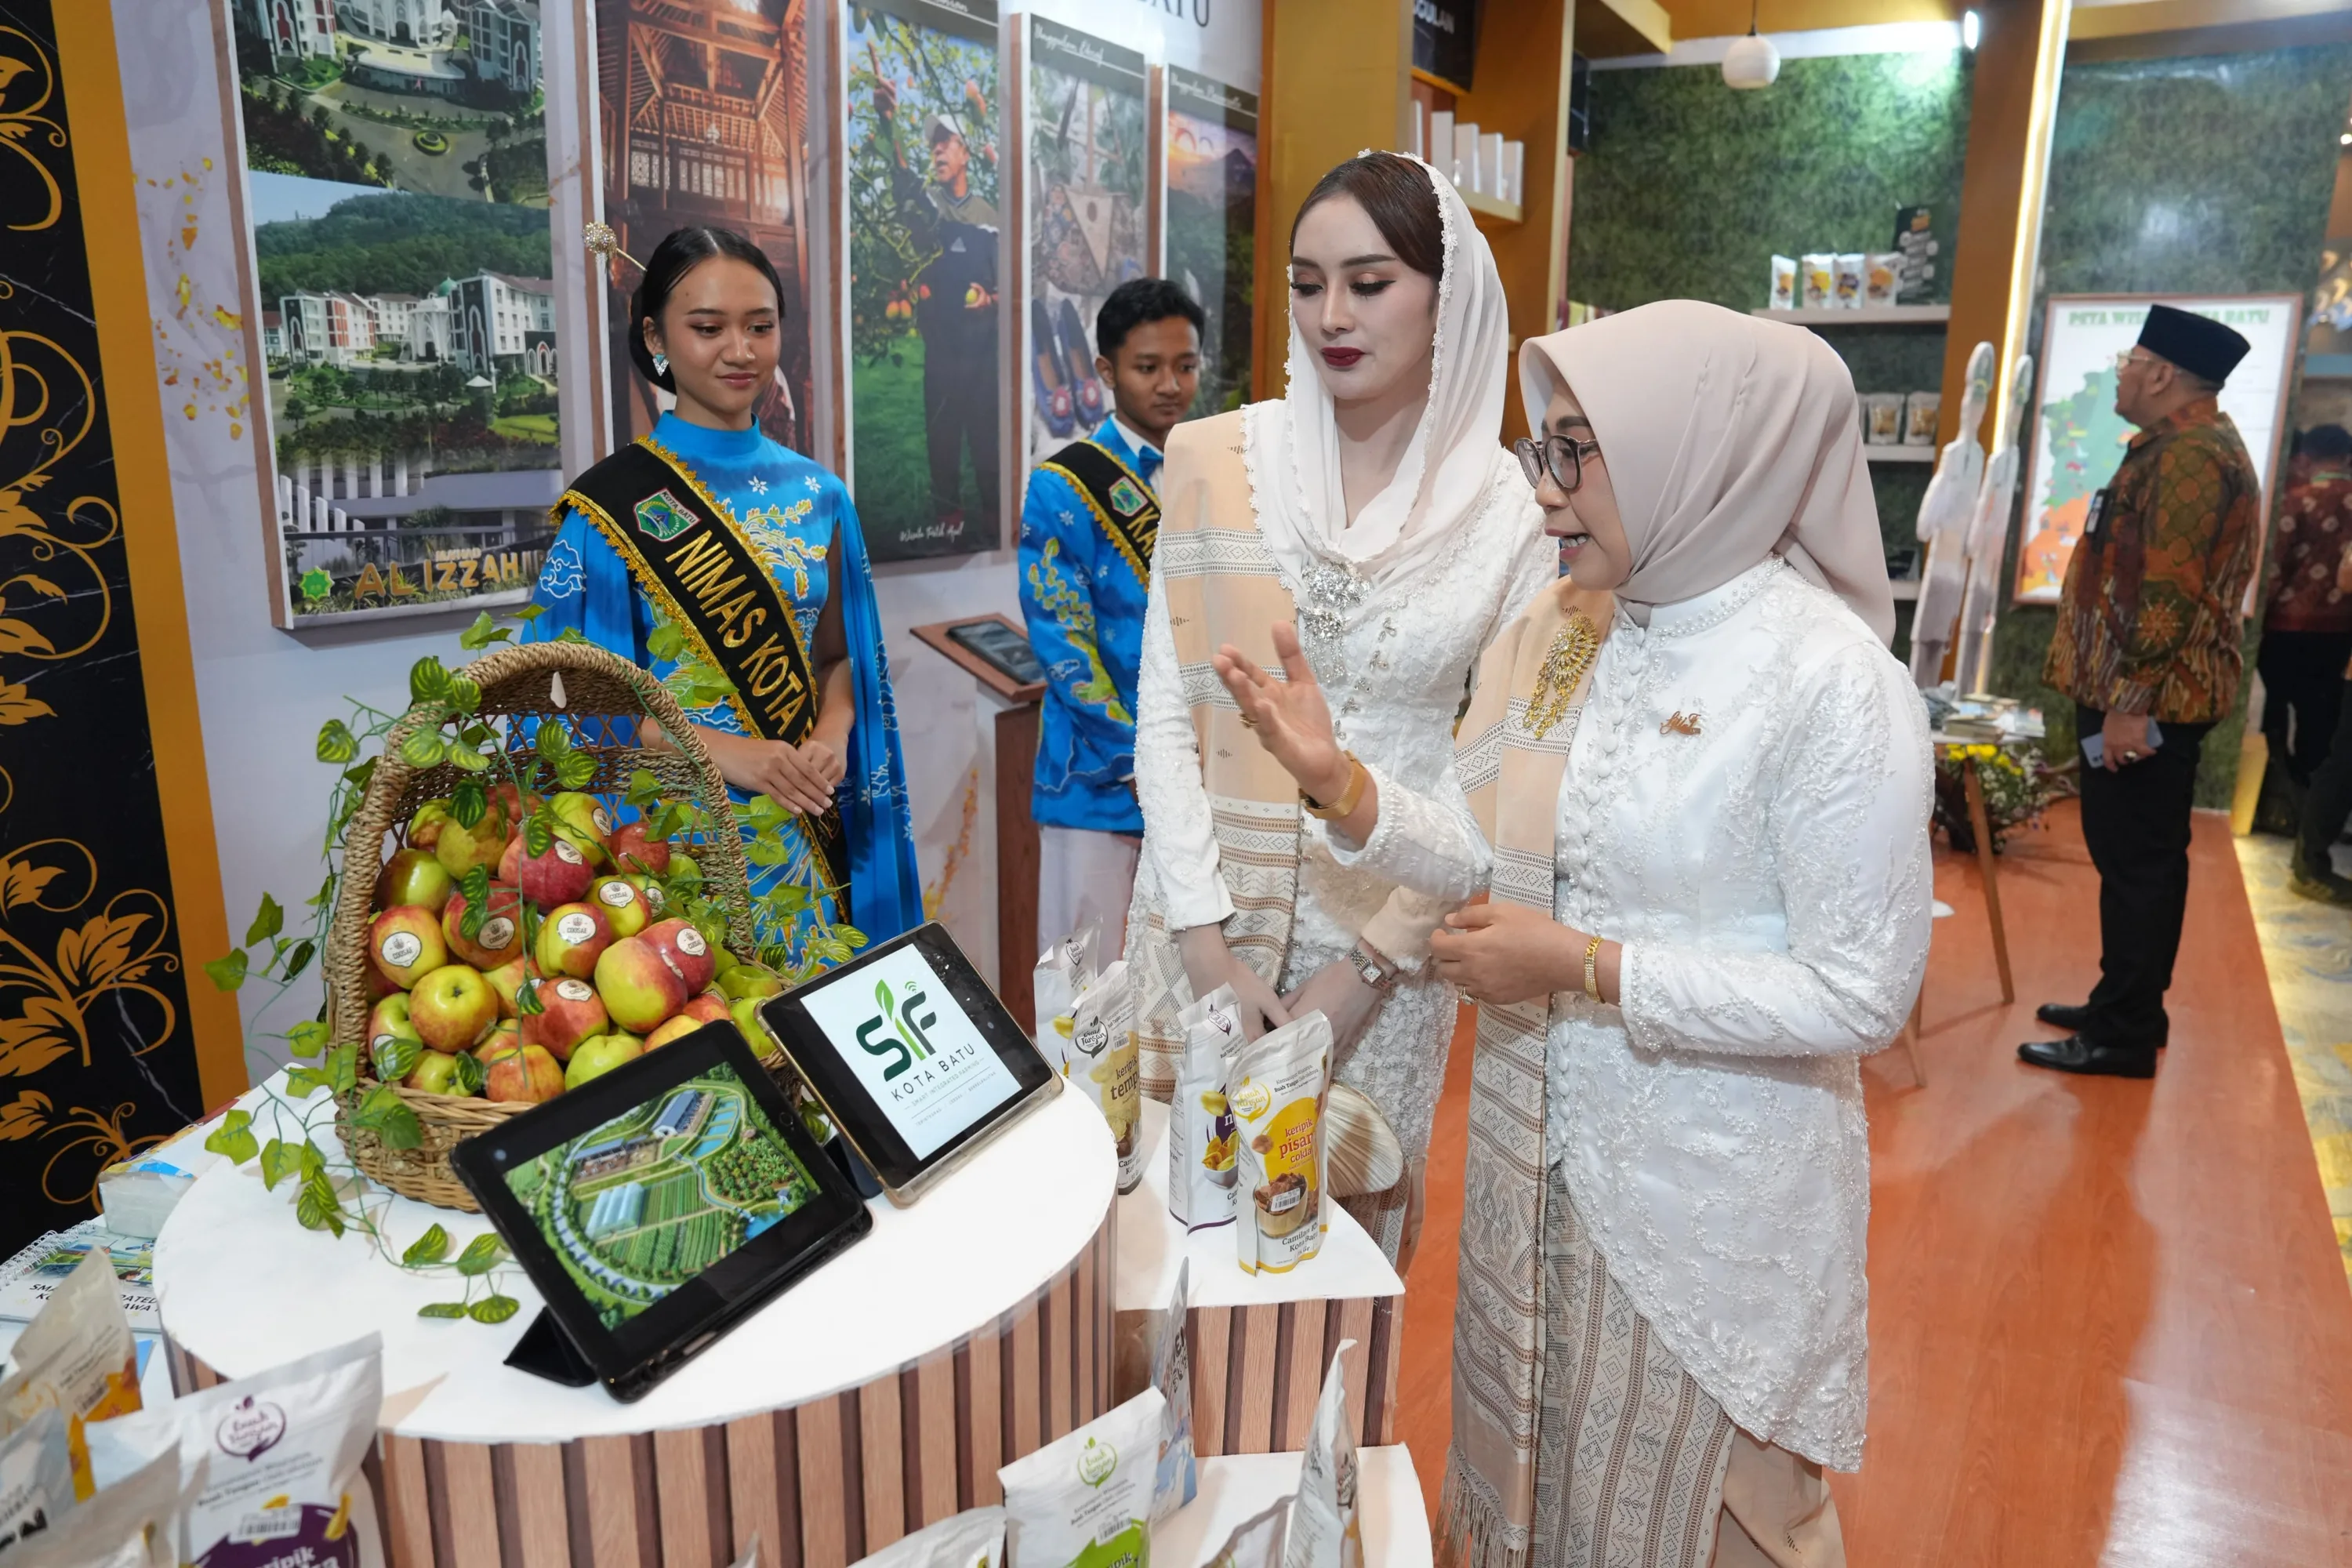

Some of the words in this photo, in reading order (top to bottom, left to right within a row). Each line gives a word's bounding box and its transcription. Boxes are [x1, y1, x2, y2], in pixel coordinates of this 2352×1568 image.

[662, 492, 679, 510] KOTA
[678, 509, 696, 524] BATU
[355, 561, 416, 600] AL
[423, 552, 520, 592] IZZAH
[666, 529, 768, 648] NIMAS
[739, 632, 808, 737] KOTA
[891, 1069, 935, 1102] KOTA
[938, 1044, 975, 1073] BATU
[1116, 1055, 1138, 1080] keripik
[912, 1093, 929, 1106] SMART
[930, 1073, 959, 1095] INTEGRATED
[1111, 1071, 1140, 1100] temp
[1285, 1118, 1313, 1137] keripik
